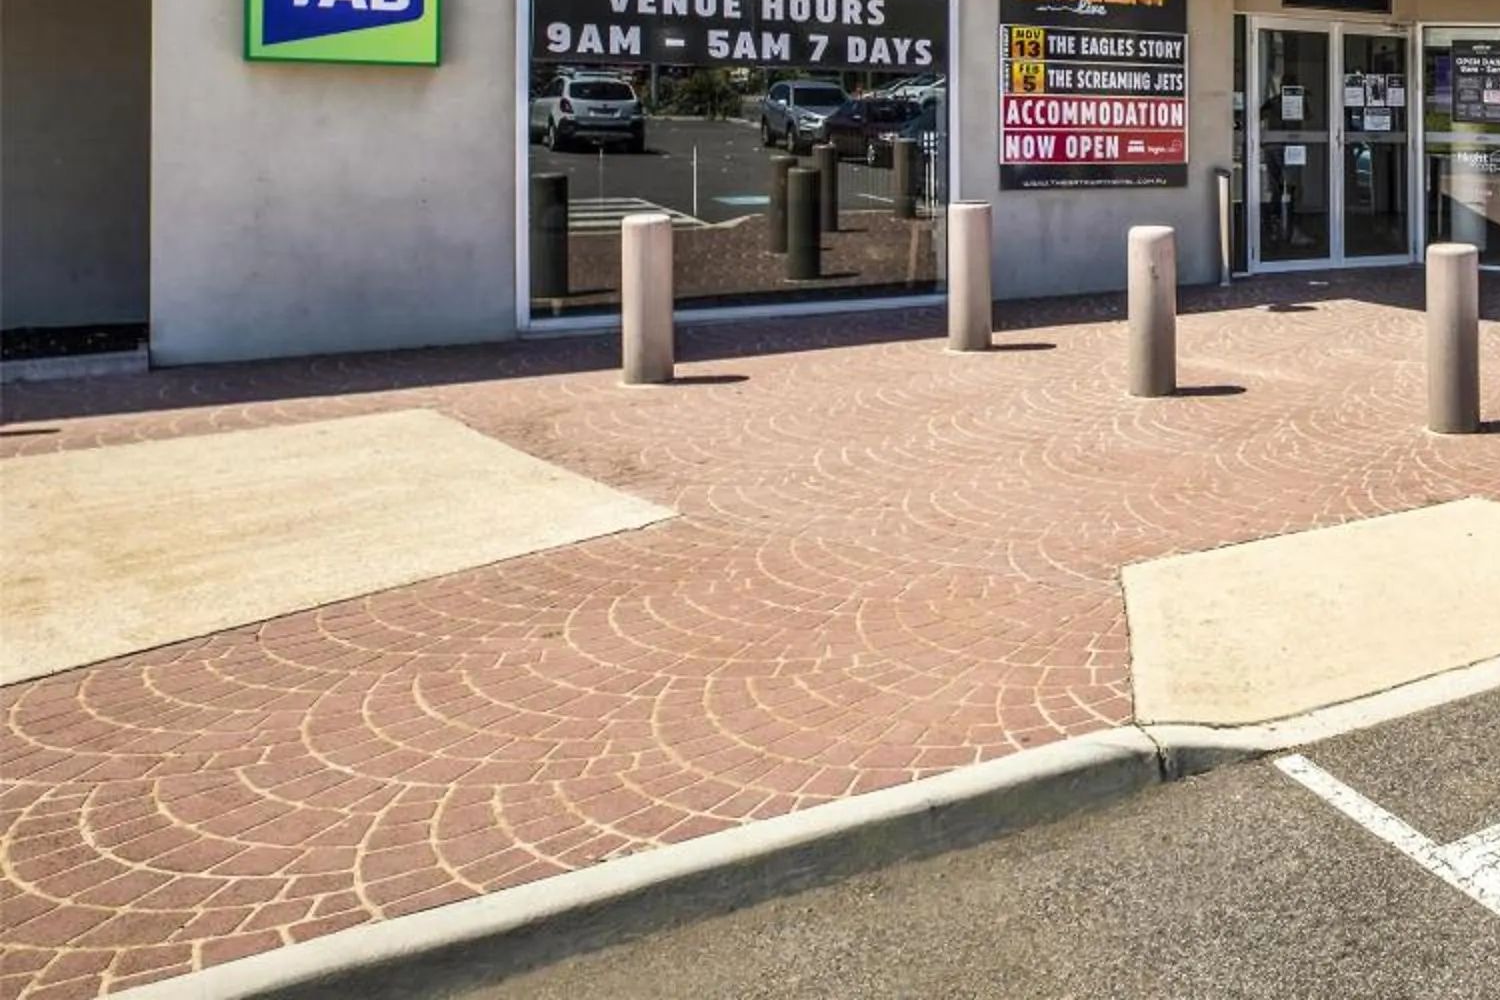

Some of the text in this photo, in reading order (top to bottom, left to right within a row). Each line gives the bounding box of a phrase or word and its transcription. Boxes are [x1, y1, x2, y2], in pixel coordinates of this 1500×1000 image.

[546, 22, 641, 55] 9AM
[707, 30, 791, 61] 5AM
[809, 34, 829, 62] 7
[847, 36, 933, 66] DAYS
[1016, 30, 1042, 40] NOV
[1016, 41, 1041, 57] 13
[1048, 35, 1182, 59] THE EAGLES STORY
[1019, 65, 1040, 74] FEB
[1048, 69, 1183, 91] THE SCREAMING JETS
[1023, 75, 1037, 93] 5
[1006, 100, 1183, 126] ACCOMMODATION
[1005, 135, 1119, 159] NOW OPEN
